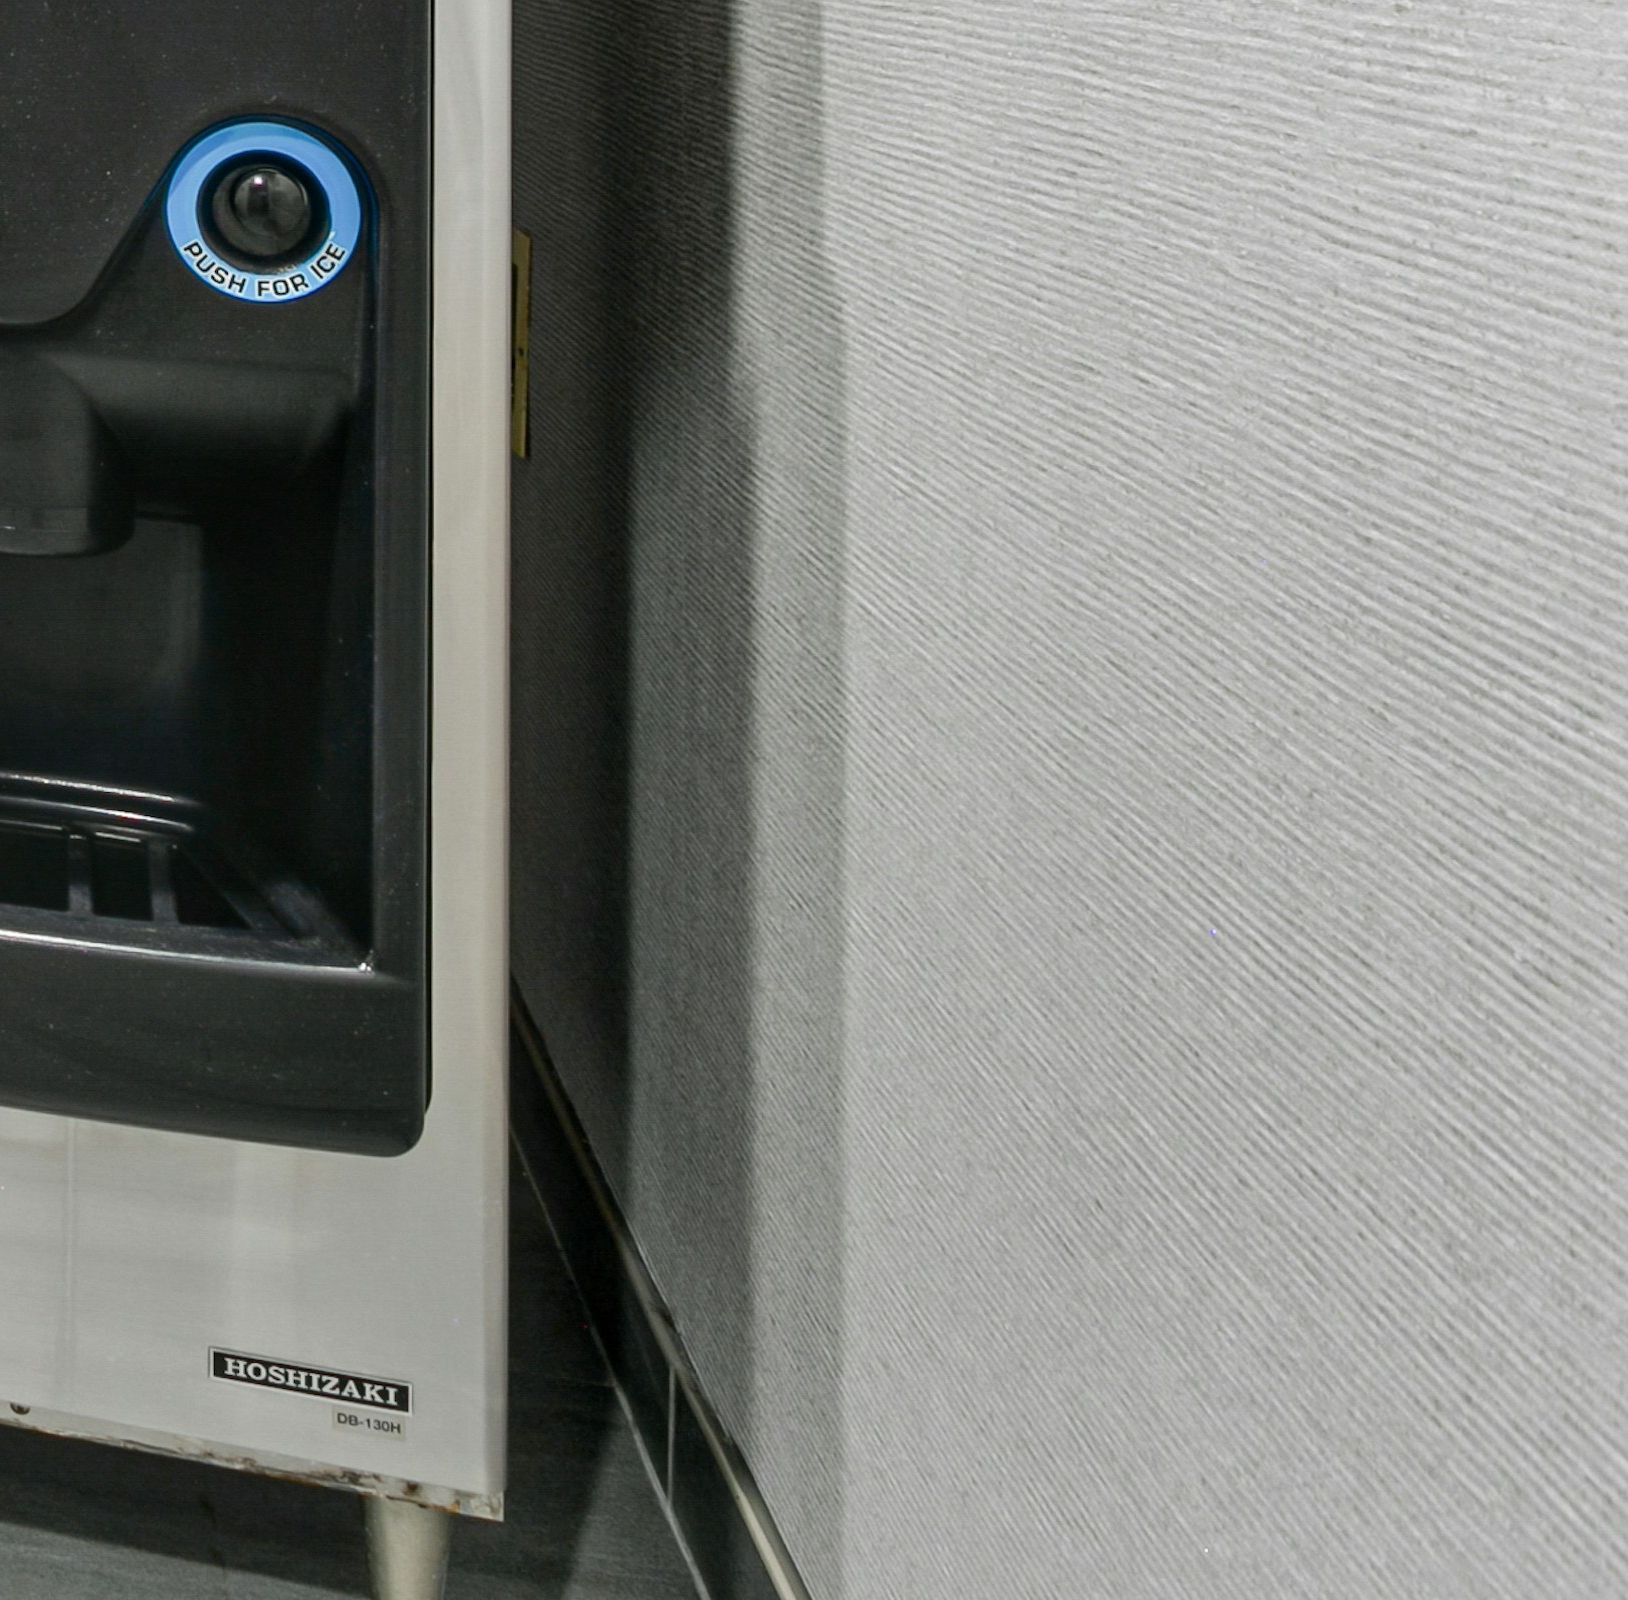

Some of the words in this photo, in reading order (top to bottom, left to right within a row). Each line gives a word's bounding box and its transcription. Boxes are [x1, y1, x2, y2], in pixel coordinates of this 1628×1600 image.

[183, 241, 246, 293] PUSH
[257, 273, 309, 297] FOR
[310, 243, 346, 280] ICE
[223, 1356, 399, 1406] HOSHIZAKI
[336, 1412, 402, 1435] DB-130H
